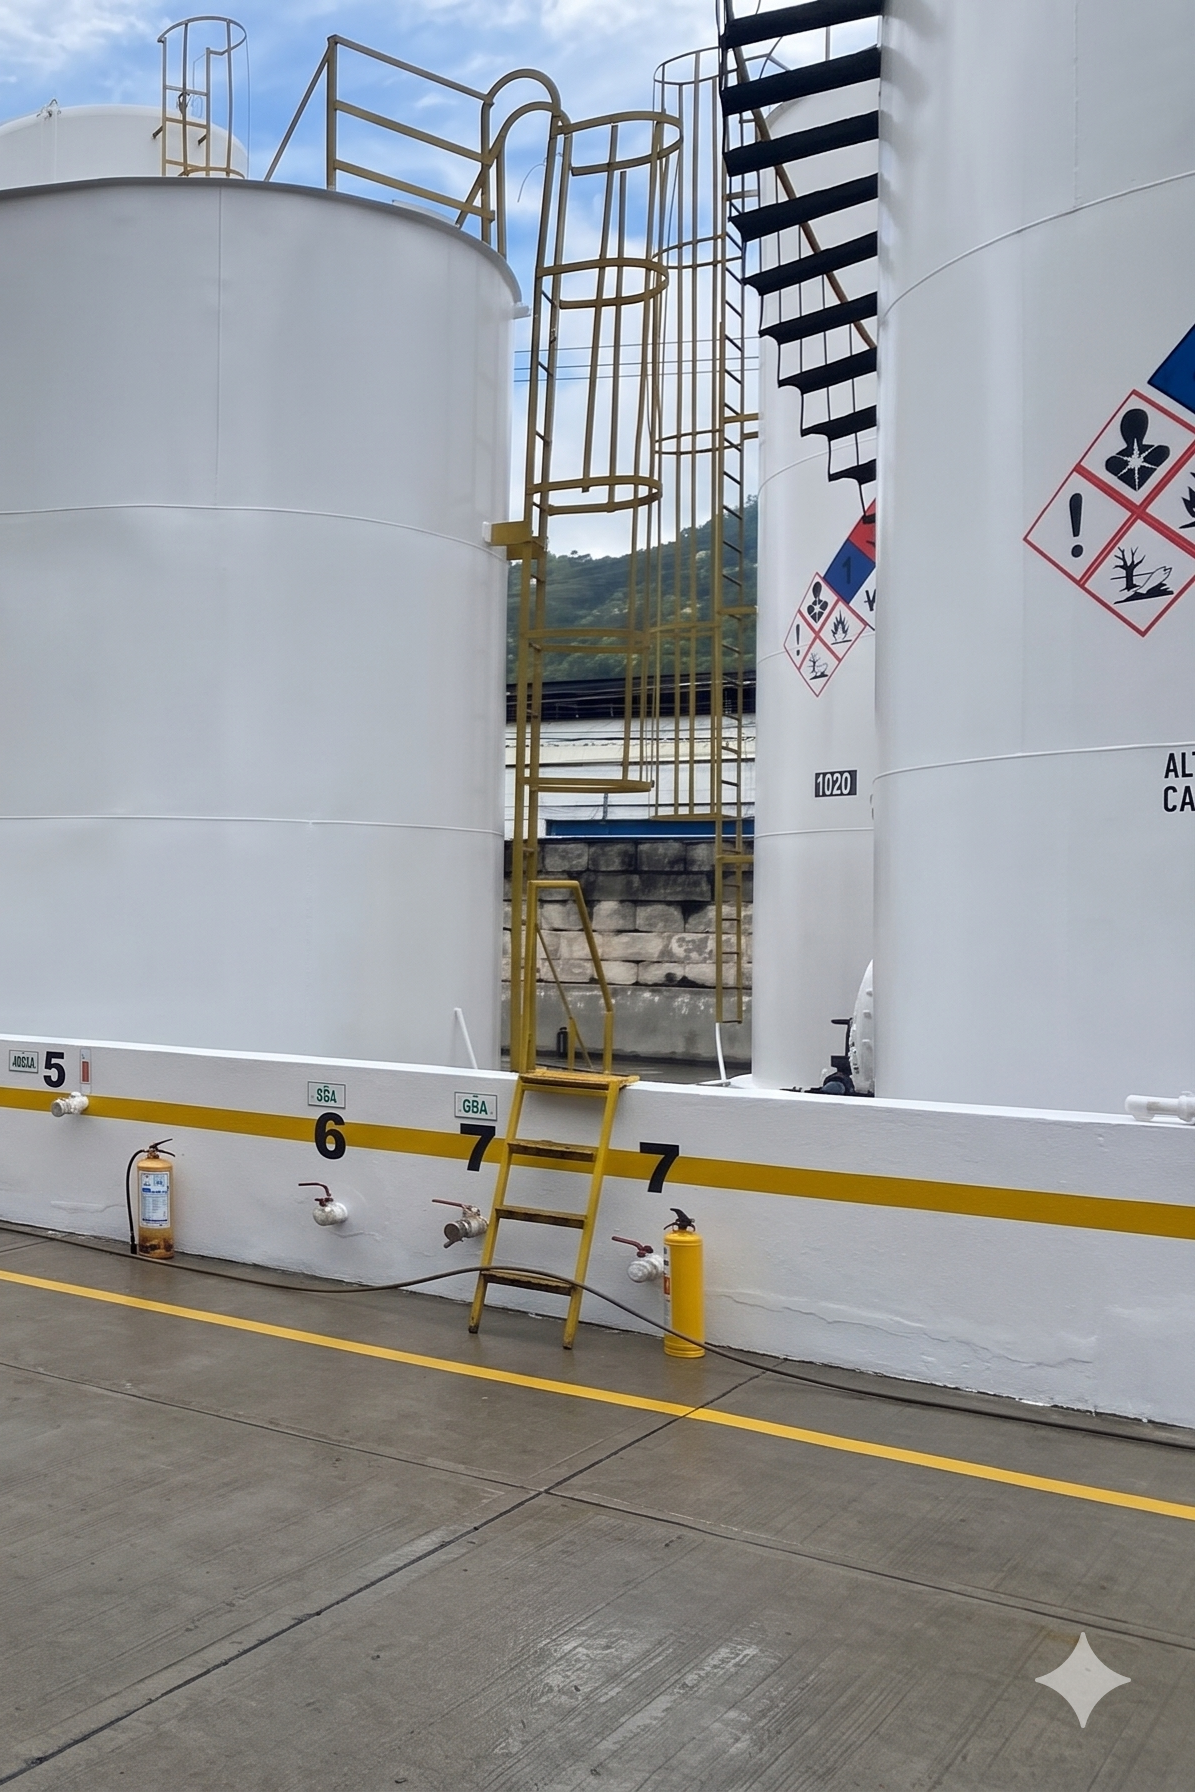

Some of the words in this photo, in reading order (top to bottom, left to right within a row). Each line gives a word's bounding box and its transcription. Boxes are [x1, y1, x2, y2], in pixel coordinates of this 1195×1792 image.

[816, 772, 851, 796] 1020
[1163, 752, 1195, 778] AL
[43, 1050, 66, 1088] 5
[314, 1111, 347, 1160] 6
[460, 1123, 496, 1172] 7
[639, 1142, 680, 1193] 7
